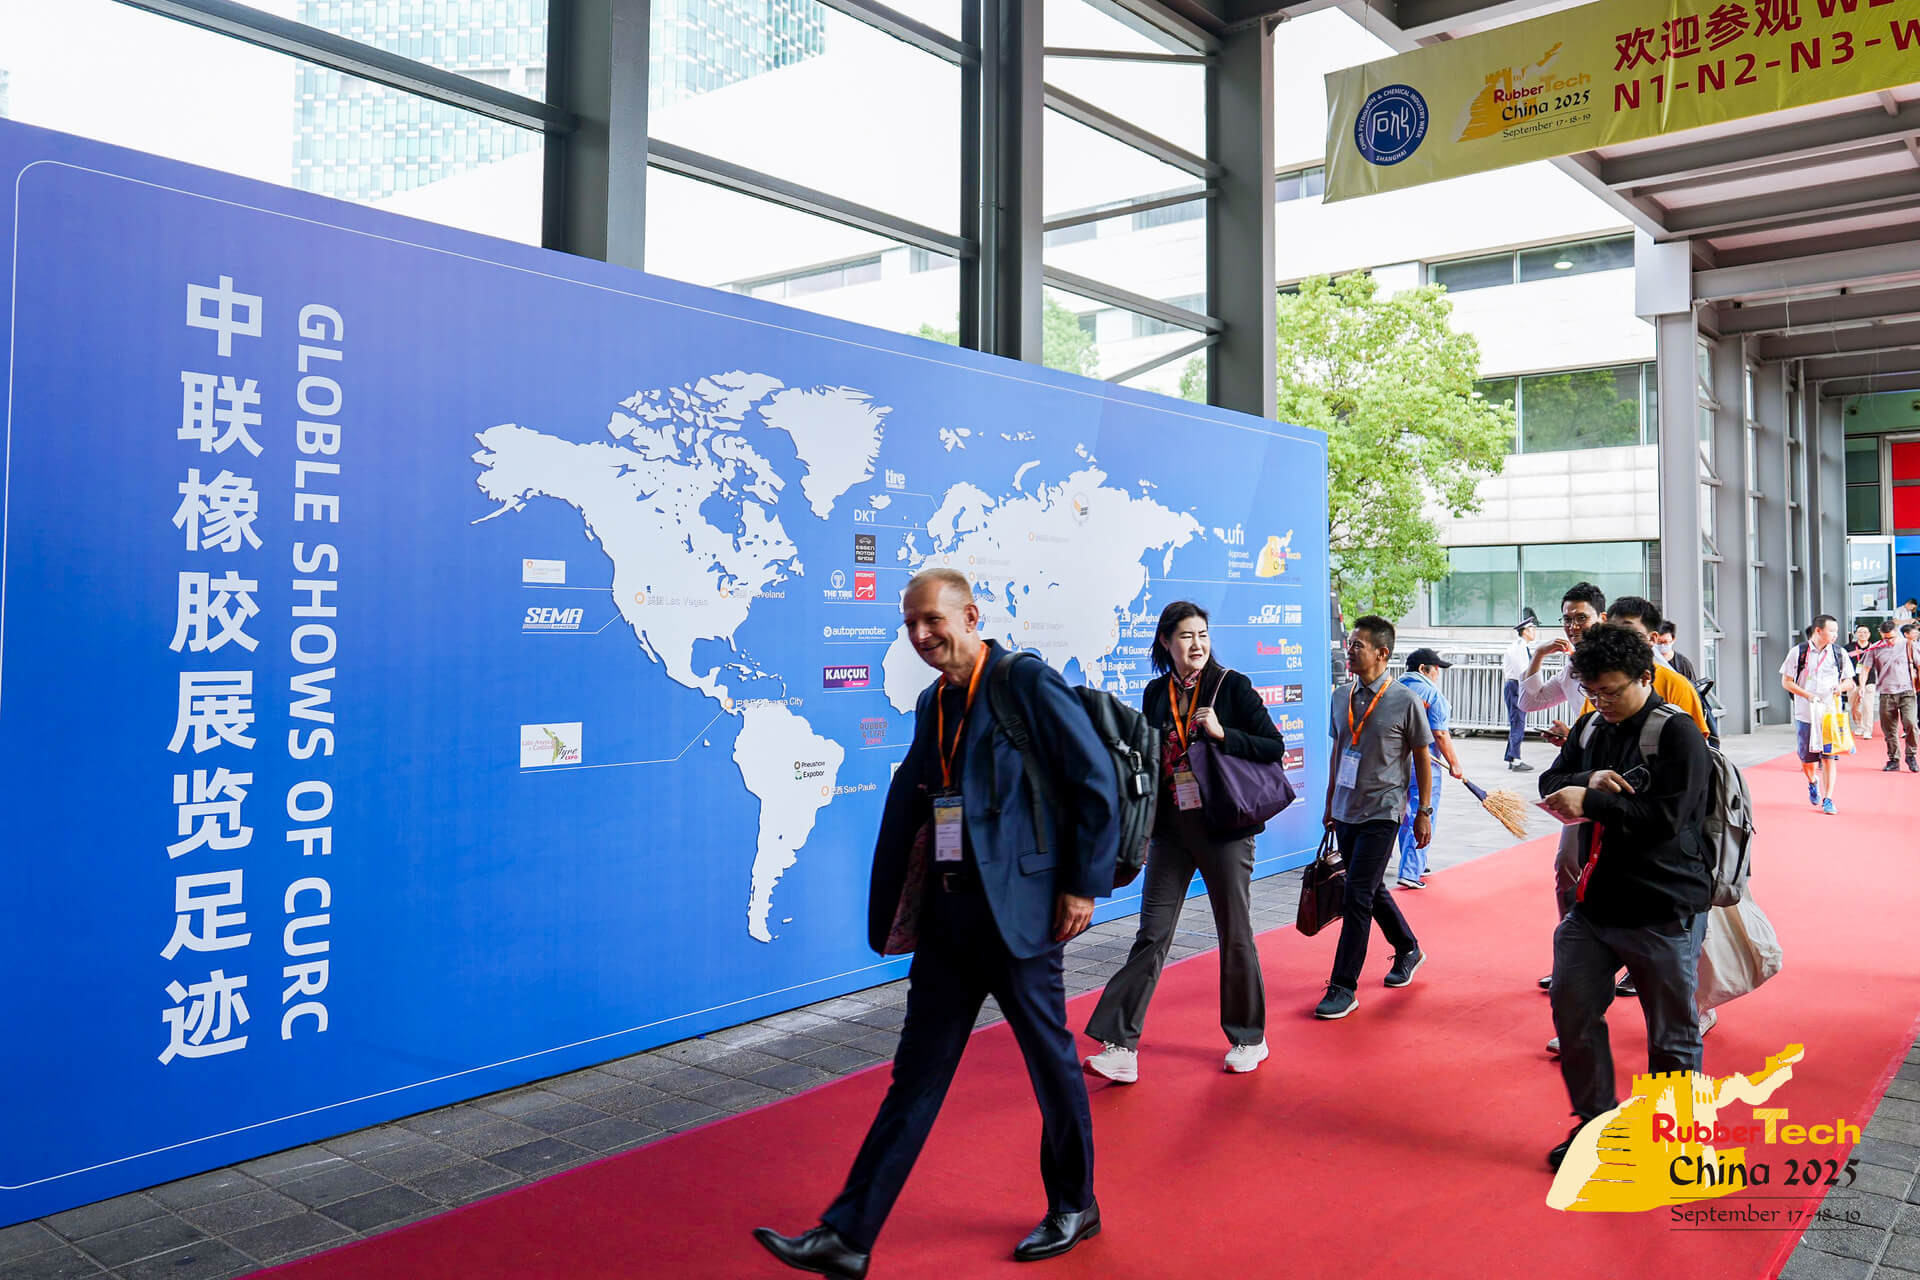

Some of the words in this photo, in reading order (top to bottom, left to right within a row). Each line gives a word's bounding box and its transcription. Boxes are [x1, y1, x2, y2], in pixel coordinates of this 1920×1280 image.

[1613, 0, 1801, 72] 欢迎参观
[1493, 72, 1592, 104] RubberTech
[1502, 101, 1549, 121] China
[1554, 89, 1591, 110] 2025
[1503, 121, 1554, 138] September
[294, 302, 345, 525] GLOBLE
[854, 509, 877, 522] DKT
[524, 607, 584, 624] SEMA
[833, 626, 887, 637] autopromotec
[287, 541, 340, 761] SHOWS
[157, 274, 265, 1067] 中联橡胶展览足迹
[825, 667, 868, 682] KAUÇUK
[285, 778, 334, 858] OF
[280, 875, 333, 1041] CURC
